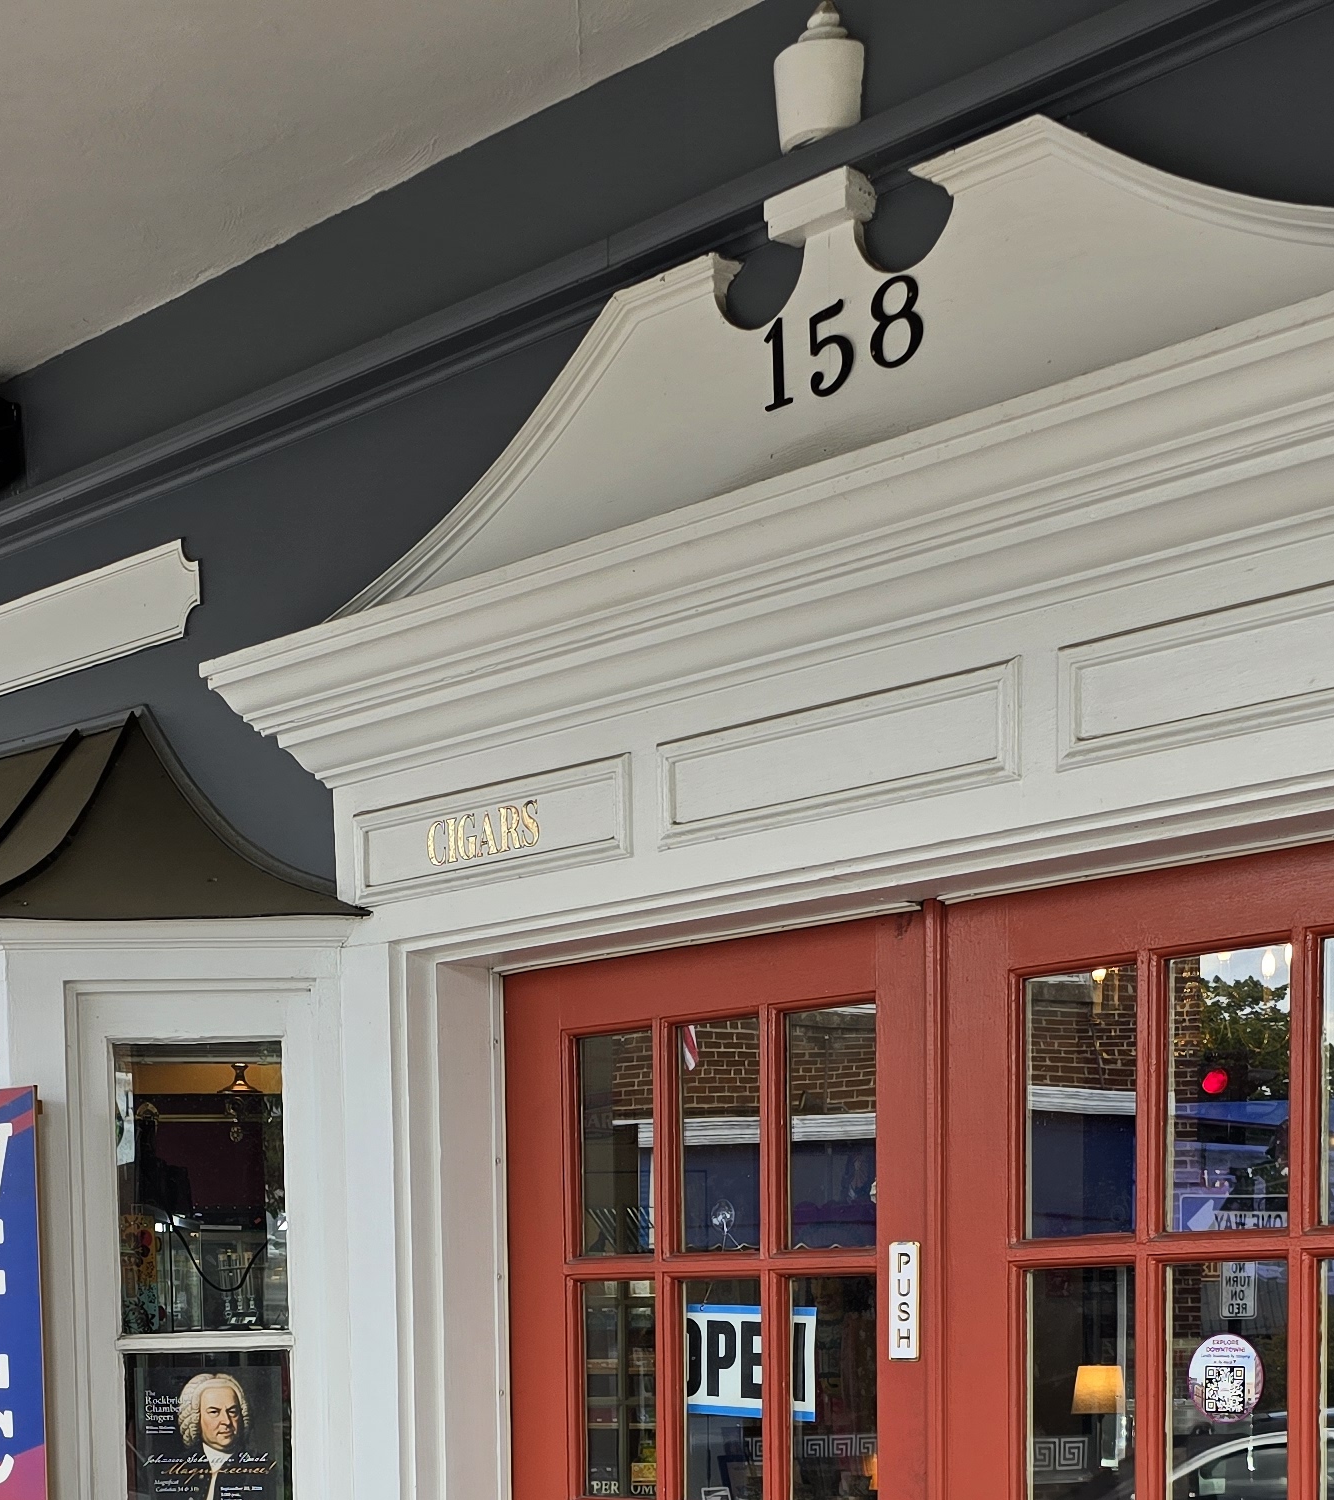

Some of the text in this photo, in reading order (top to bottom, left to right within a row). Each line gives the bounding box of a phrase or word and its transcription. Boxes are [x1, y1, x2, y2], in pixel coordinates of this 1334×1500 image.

[764, 275, 924, 412] 158
[427, 799, 540, 866] CIGARS
[896, 1252, 911, 1349] PUSH
[145, 1413, 174, 1423] Singers
